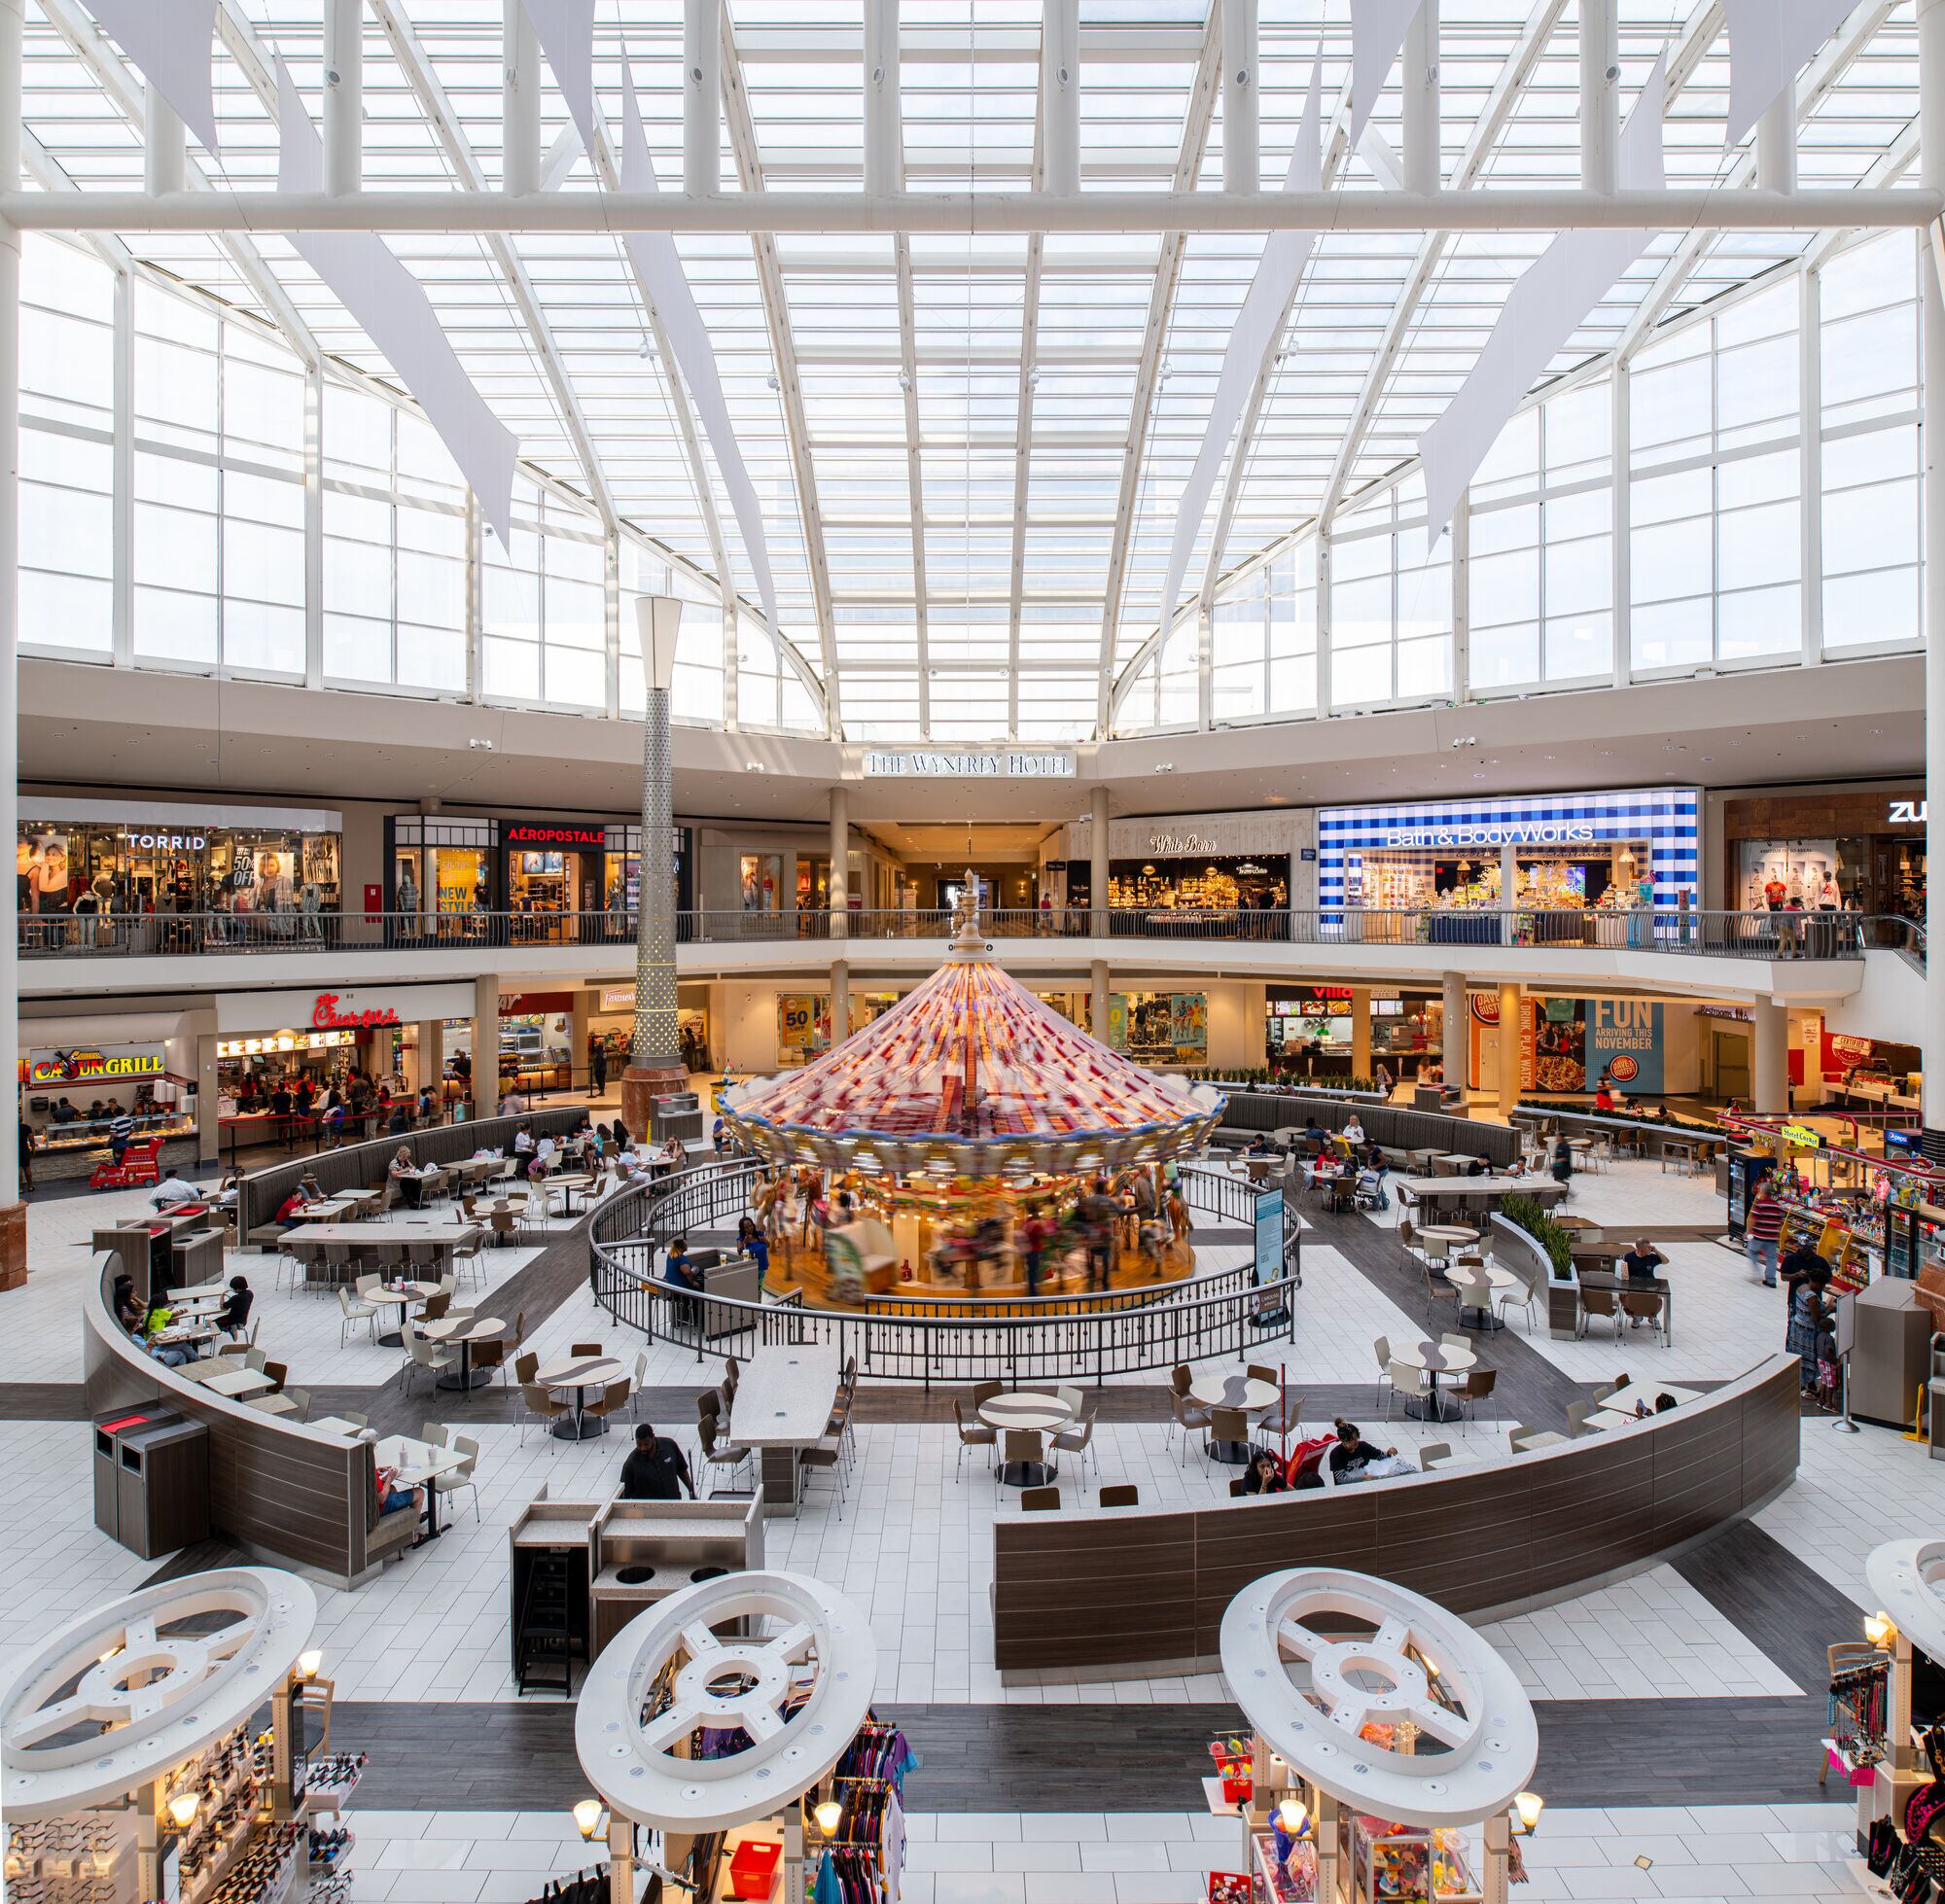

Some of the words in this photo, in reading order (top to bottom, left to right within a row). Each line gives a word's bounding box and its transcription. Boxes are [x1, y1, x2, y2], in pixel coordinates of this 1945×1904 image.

[867, 754, 906, 774] THE
[912, 754, 1002, 774] WYNFREY
[1008, 754, 1074, 774] HOTEL
[126, 834, 205, 850] TORRID
[508, 827, 605, 843] AÉROPOSTALE
[1387, 829, 1434, 847] Bath
[1438, 827, 1455, 845] &
[1458, 824, 1516, 847] Body
[1517, 822, 1594, 843] Works
[1149, 835, 1183, 854] White
[1185, 834, 1217, 852] Barn
[440, 887, 468, 899] NEW
[312, 993, 400, 1029] Chick-fil-A
[786, 1010, 808, 1027] 50
[1596, 1000, 1651, 1028] FUN
[1701, 1005, 1732, 1019] Restrooms
[1596, 1028, 1633, 1038] ARRIVING
[1635, 1028, 1652, 1038] THIS
[1595, 1038, 1652, 1049] NOVEMBER
[1840, 1037, 1865, 1047] CERTIFIED
[106, 1056, 164, 1075] GRILL
[1783, 1128, 1799, 1140] Street
[1800, 1131, 1818, 1145] Corner
[121, 1167, 126, 1177] 7
